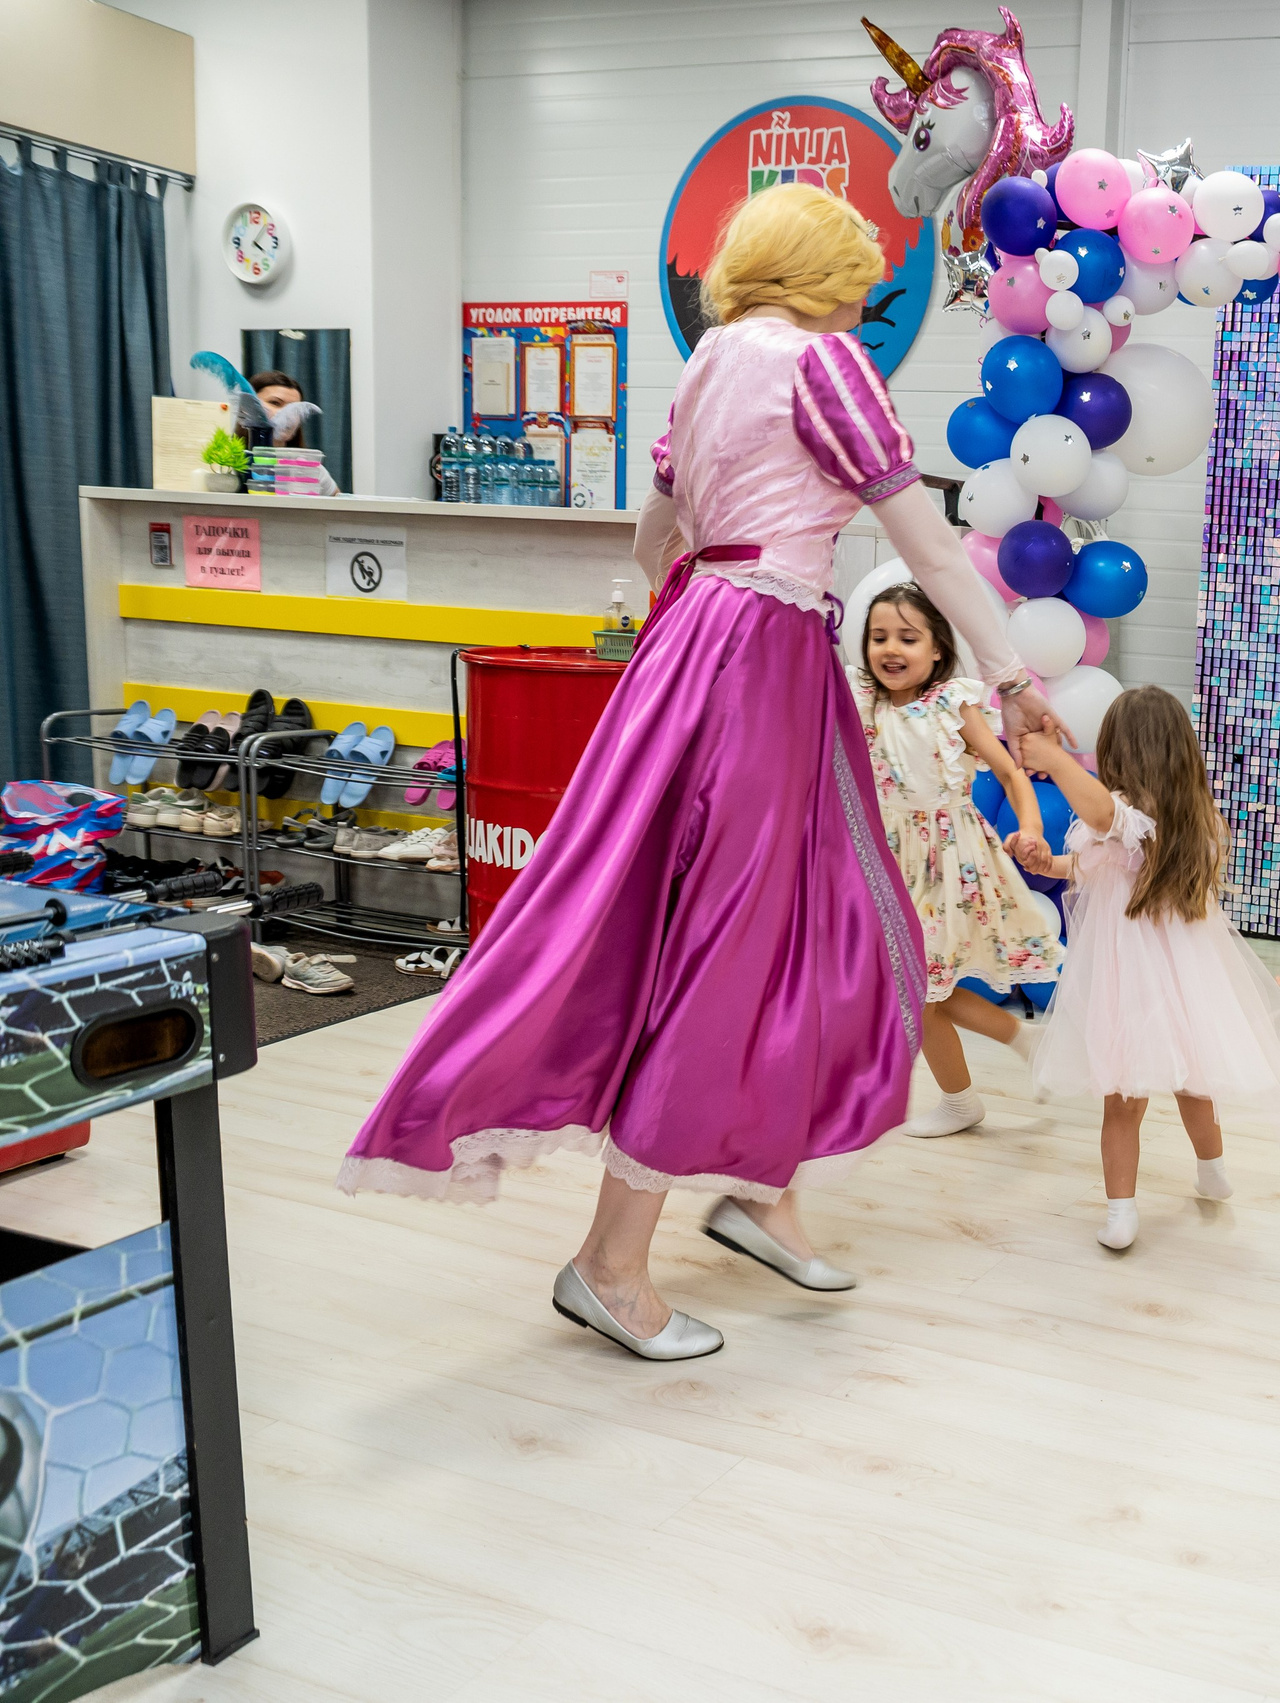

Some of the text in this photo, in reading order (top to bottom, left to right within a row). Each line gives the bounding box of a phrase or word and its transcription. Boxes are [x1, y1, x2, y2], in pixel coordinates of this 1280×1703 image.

[750, 127, 849, 168] NINJA
[249, 210, 261, 224] 12
[469, 306, 621, 323] УГОЛОК ПОТРЕБИТЕЛЯ
[194, 525, 250, 538] ТАПОЧКИ
[197, 547, 251, 558] для выхода
[200, 566, 245, 577] в туалет!
